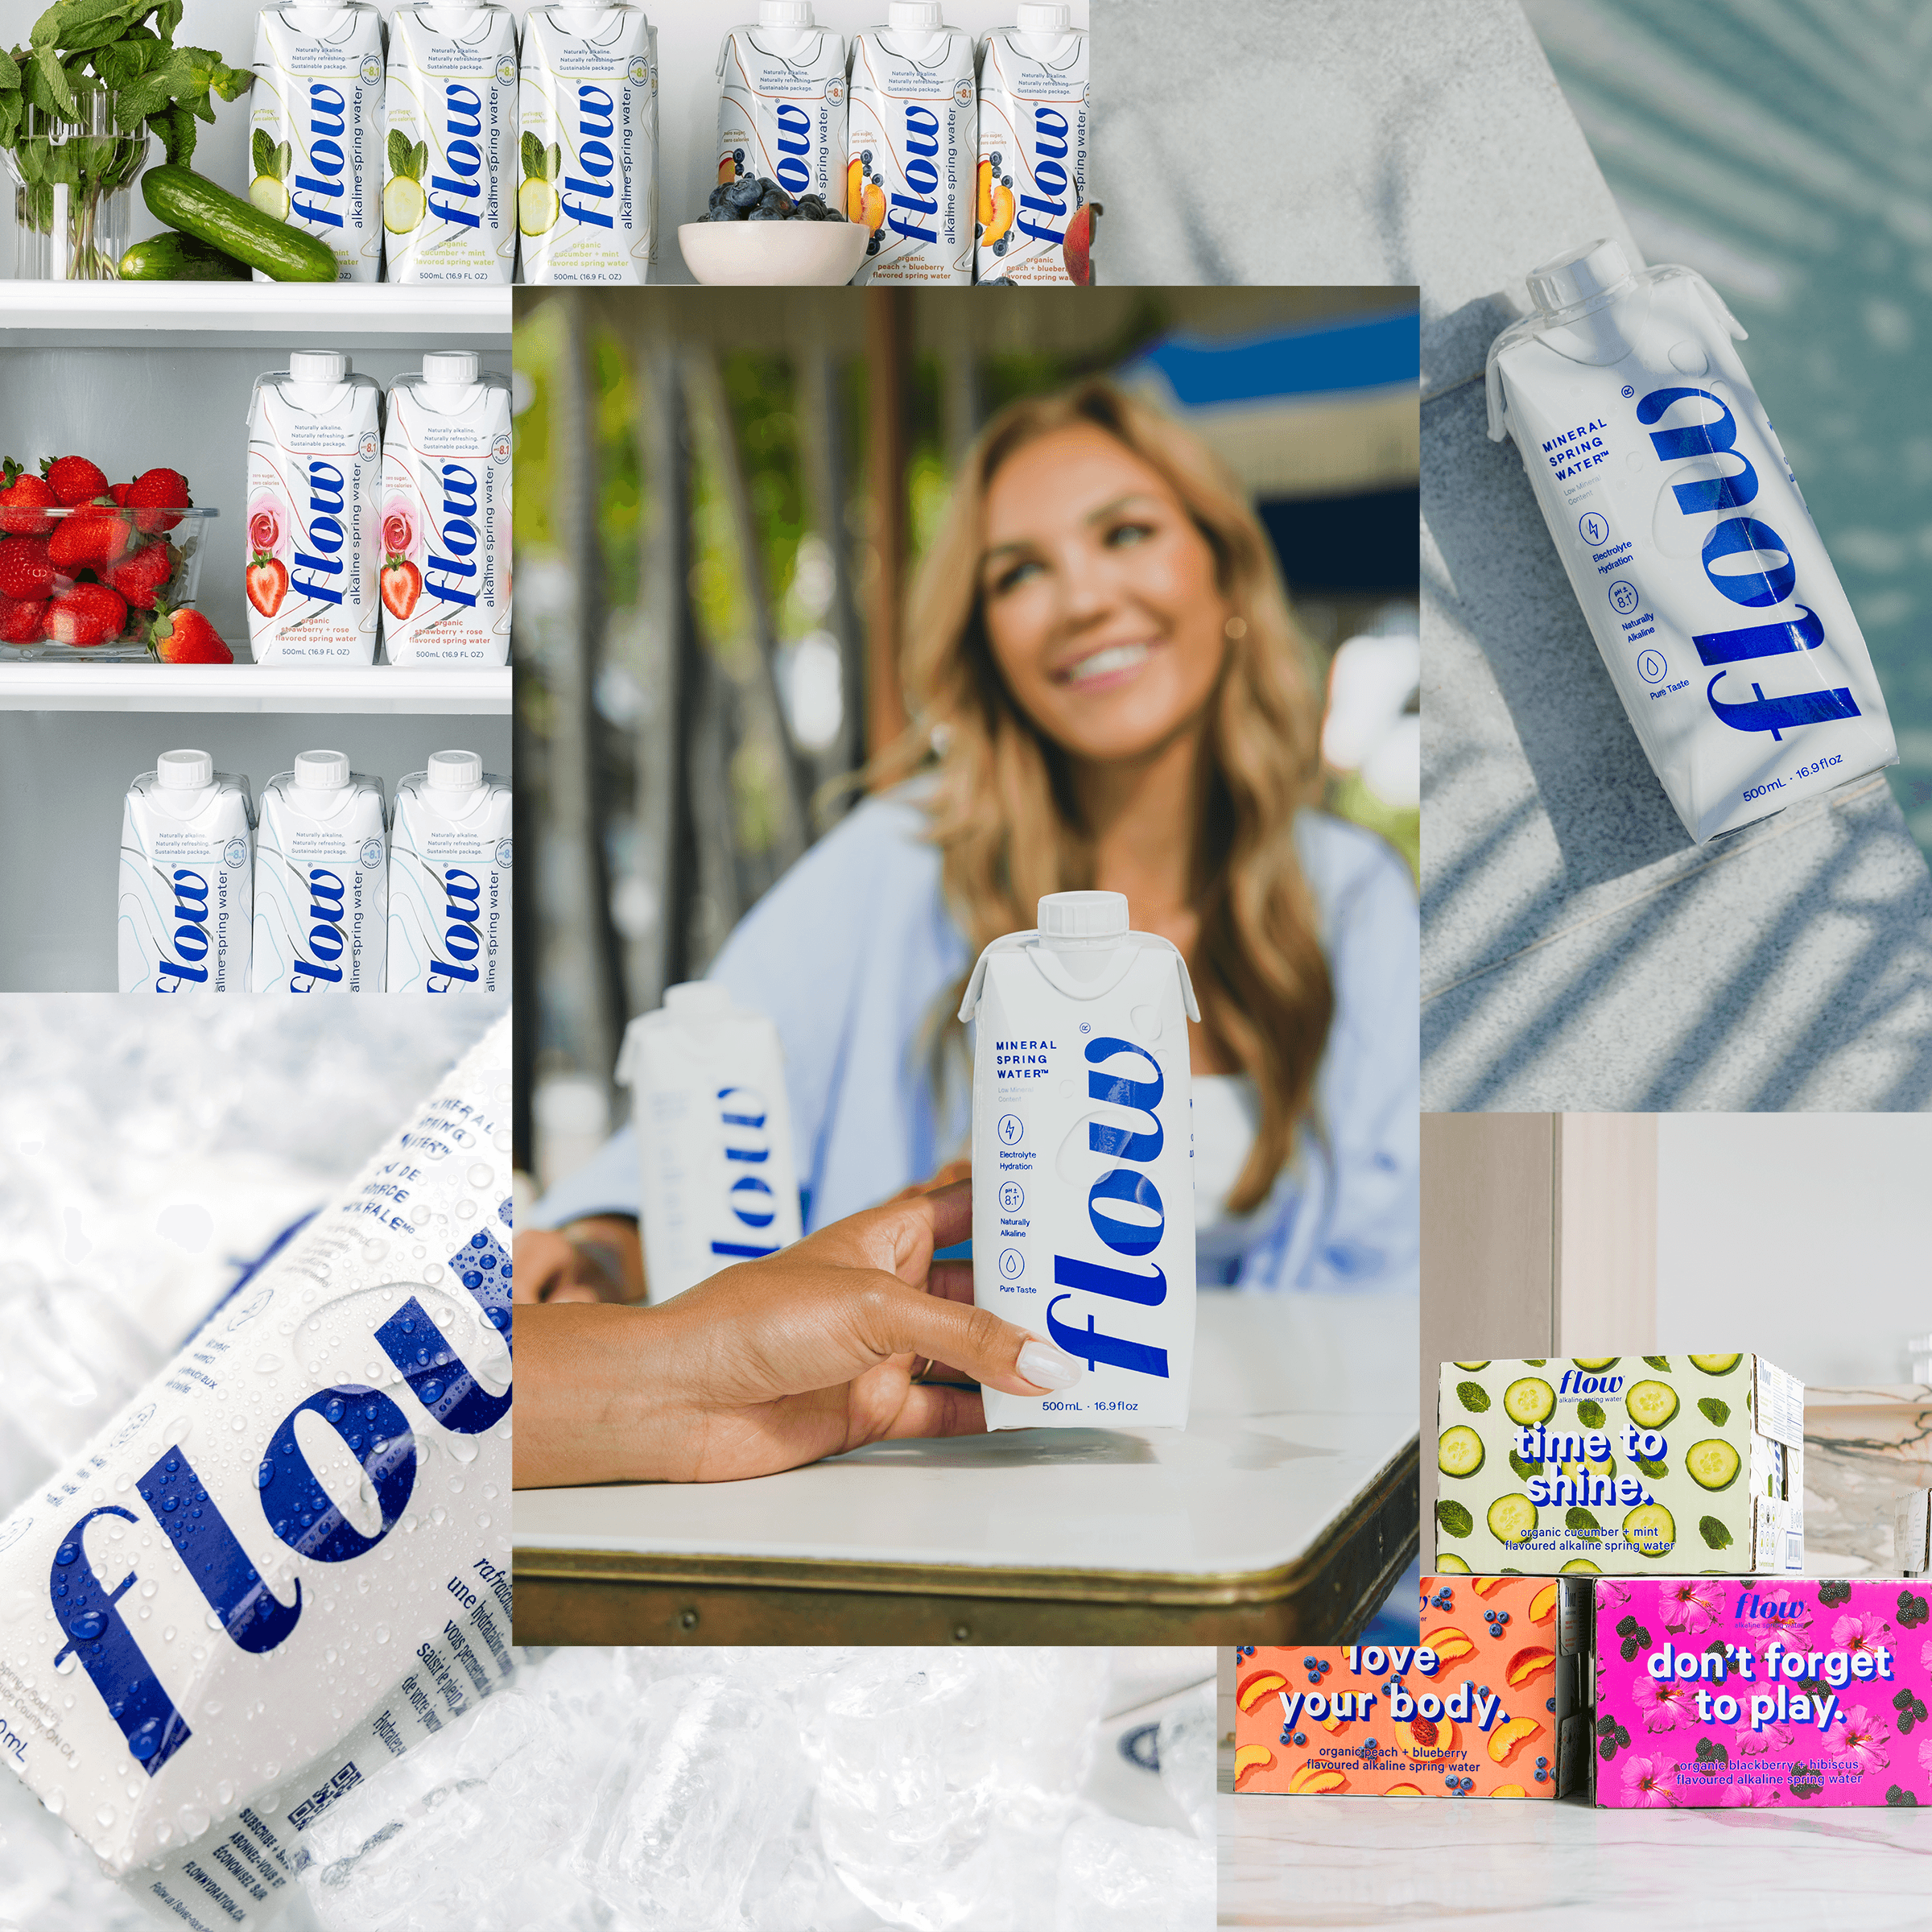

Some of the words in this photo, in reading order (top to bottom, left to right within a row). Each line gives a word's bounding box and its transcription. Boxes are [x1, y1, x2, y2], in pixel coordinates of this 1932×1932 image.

[623, 86, 633, 126] water
[292, 83, 345, 229] flow
[428, 84, 482, 229] flow
[561, 85, 614, 229] flow
[623, 129, 634, 173] spring
[888, 105, 939, 245] flow
[949, 147, 959, 190] spring
[1017, 106, 1070, 246] flow
[620, 176, 633, 229] alkaline
[945, 192, 956, 245] alkaline
[553, 273, 579, 281] 500mL
[598, 273, 606, 281] FL
[1542, 419, 1608, 452] MINERAL
[1549, 436, 1604, 467] SPRING
[353, 462, 361, 502] water
[1567, 489, 1594, 506] Content
[291, 460, 345, 605] flow
[351, 504, 363, 548] spring
[424, 464, 478, 608] flow
[1592, 540, 1633, 563] Electrolyte
[1597, 554, 1634, 575] Hydration
[1637, 387, 1863, 742] flow
[350, 551, 361, 605] alkaline
[1621, 613, 1654, 631] Naturally
[1627, 625, 1655, 643] Alkaline
[1649, 688, 1667, 700] Pure
[1666, 679, 1690, 693] Taste
[355, 870, 363, 909] water
[354, 912, 365, 956] spring
[996, 1040, 1057, 1051] MINERAL
[997, 1055, 1047, 1064] SPRING
[999, 1151, 1037, 1159] Electrolyte
[999, 1162, 1033, 1170] Hydration
[1000, 1218, 1030, 1228] Naturally
[1046, 1037, 1170, 1379] flow
[1000, 1230, 1026, 1238] Alkaline
[999, 1285, 1015, 1293] Pure
[1016, 1286, 1037, 1294] Taste
[1513, 1421, 1611, 1463] time
[1619, 1423, 1668, 1462] to
[1525, 1463, 1654, 1507] shine.
[1505, 1540, 1556, 1551] flavoured
[1559, 1540, 1602, 1551] alkaline
[1604, 1541, 1641, 1553] spring
[1643, 1542, 1675, 1551] water
[1520, 1527, 1561, 1539] organic
[1564, 1527, 1619, 1538] cucumber
[1633, 1527, 1658, 1537] mint
[447, 1575, 477, 1609] une
[444, 1620, 464, 1650] vous
[416, 1642, 446, 1676] saisir
[1349, 1646, 1440, 1676] love
[1765, 1641, 1894, 1690] forget
[409, 1687, 430, 1715] votre
[1278, 1691, 1377, 1728] your
[1390, 1683, 1511, 1732] body.
[1695, 1689, 1741, 1724] to
[1751, 1684, 1848, 1732] play.
[1307, 1760, 1360, 1770] flavoured
[1363, 1761, 1406, 1771] alkaline
[1409, 1761, 1445, 1773] spring
[1448, 1763, 1480, 1773] water
[1319, 1747, 1361, 1757] organic
[1364, 1746, 1397, 1759] peach
[1412, 1746, 1468, 1761] blueberry
[1679, 1761, 1726, 1773] organic
[1729, 1759, 1794, 1773] blackberry
[1810, 1759, 1860, 1770] hibiscus
[1676, 1774, 1734, 1785] flavoured
[1737, 1773, 1784, 1785] alkaline
[1787, 1774, 1825, 1786] spring
[1828, 1774, 1863, 1785] water
